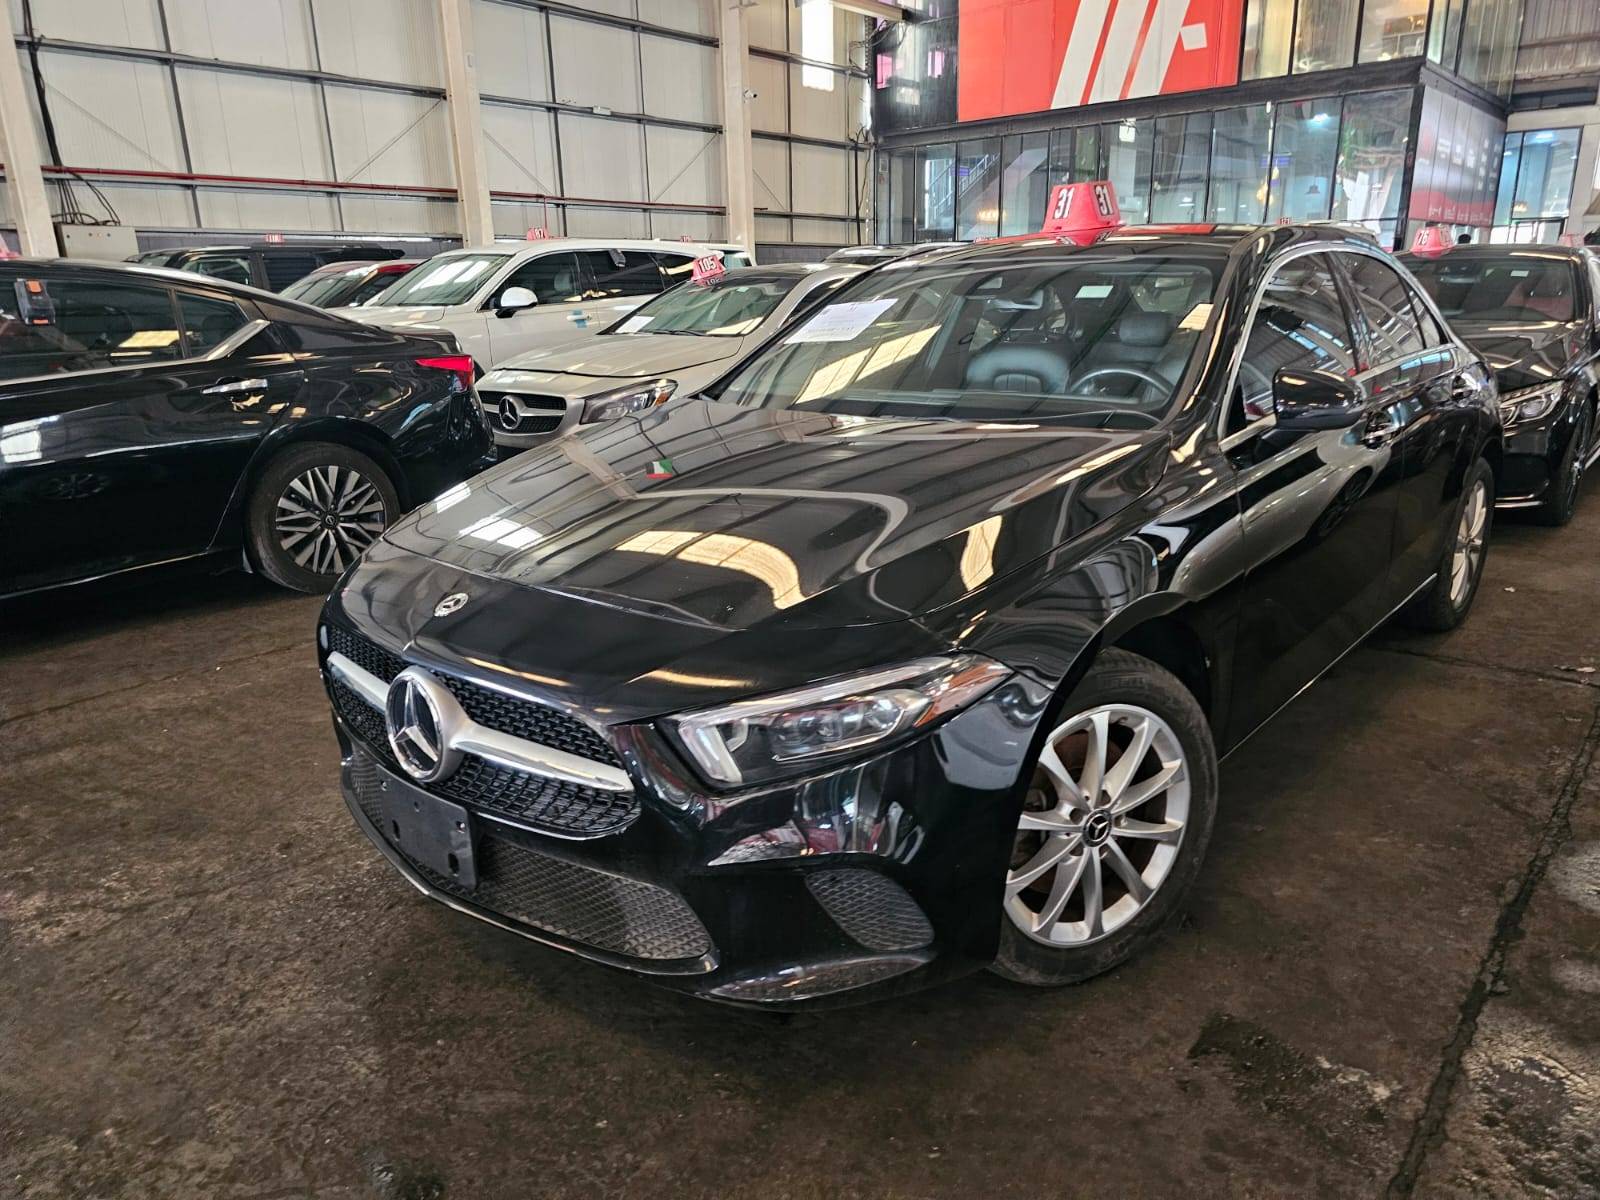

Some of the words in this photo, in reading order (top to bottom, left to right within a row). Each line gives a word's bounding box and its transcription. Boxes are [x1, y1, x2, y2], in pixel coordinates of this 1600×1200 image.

[1054, 187, 1075, 219] 31
[1095, 185, 1114, 215] 31
[1416, 230, 1429, 245] 76
[699, 256, 717, 273] 105
